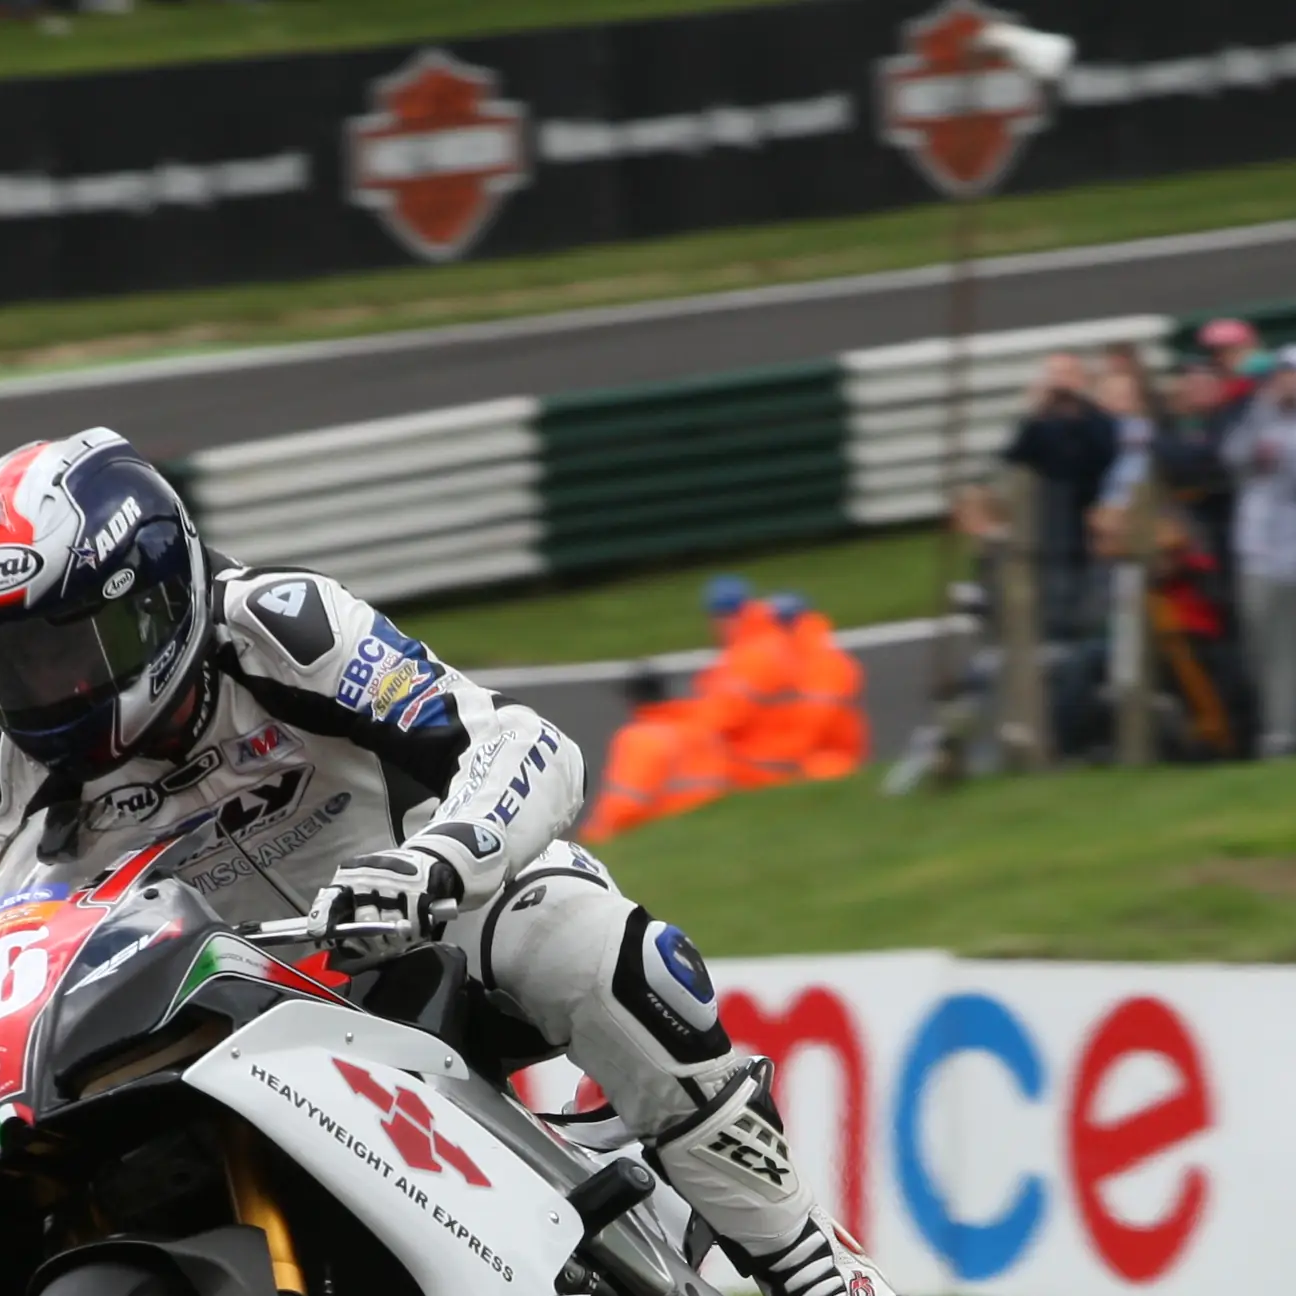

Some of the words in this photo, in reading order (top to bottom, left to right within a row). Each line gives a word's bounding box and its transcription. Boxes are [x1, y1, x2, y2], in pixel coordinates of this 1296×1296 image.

[95, 496, 142, 564] ADR
[110, 572, 129, 591] Arai
[336, 638, 385, 708] EBC
[368, 653, 399, 697] BRAKES
[376, 662, 416, 713] SUNOCO
[708, 1131, 789, 1186] TCX
[709, 983, 1214, 1284] mce
[250, 1064, 394, 1178] HEAVYWEIGHT
[395, 1175, 429, 1211] AIR
[432, 1204, 514, 1283] EXPRESS
